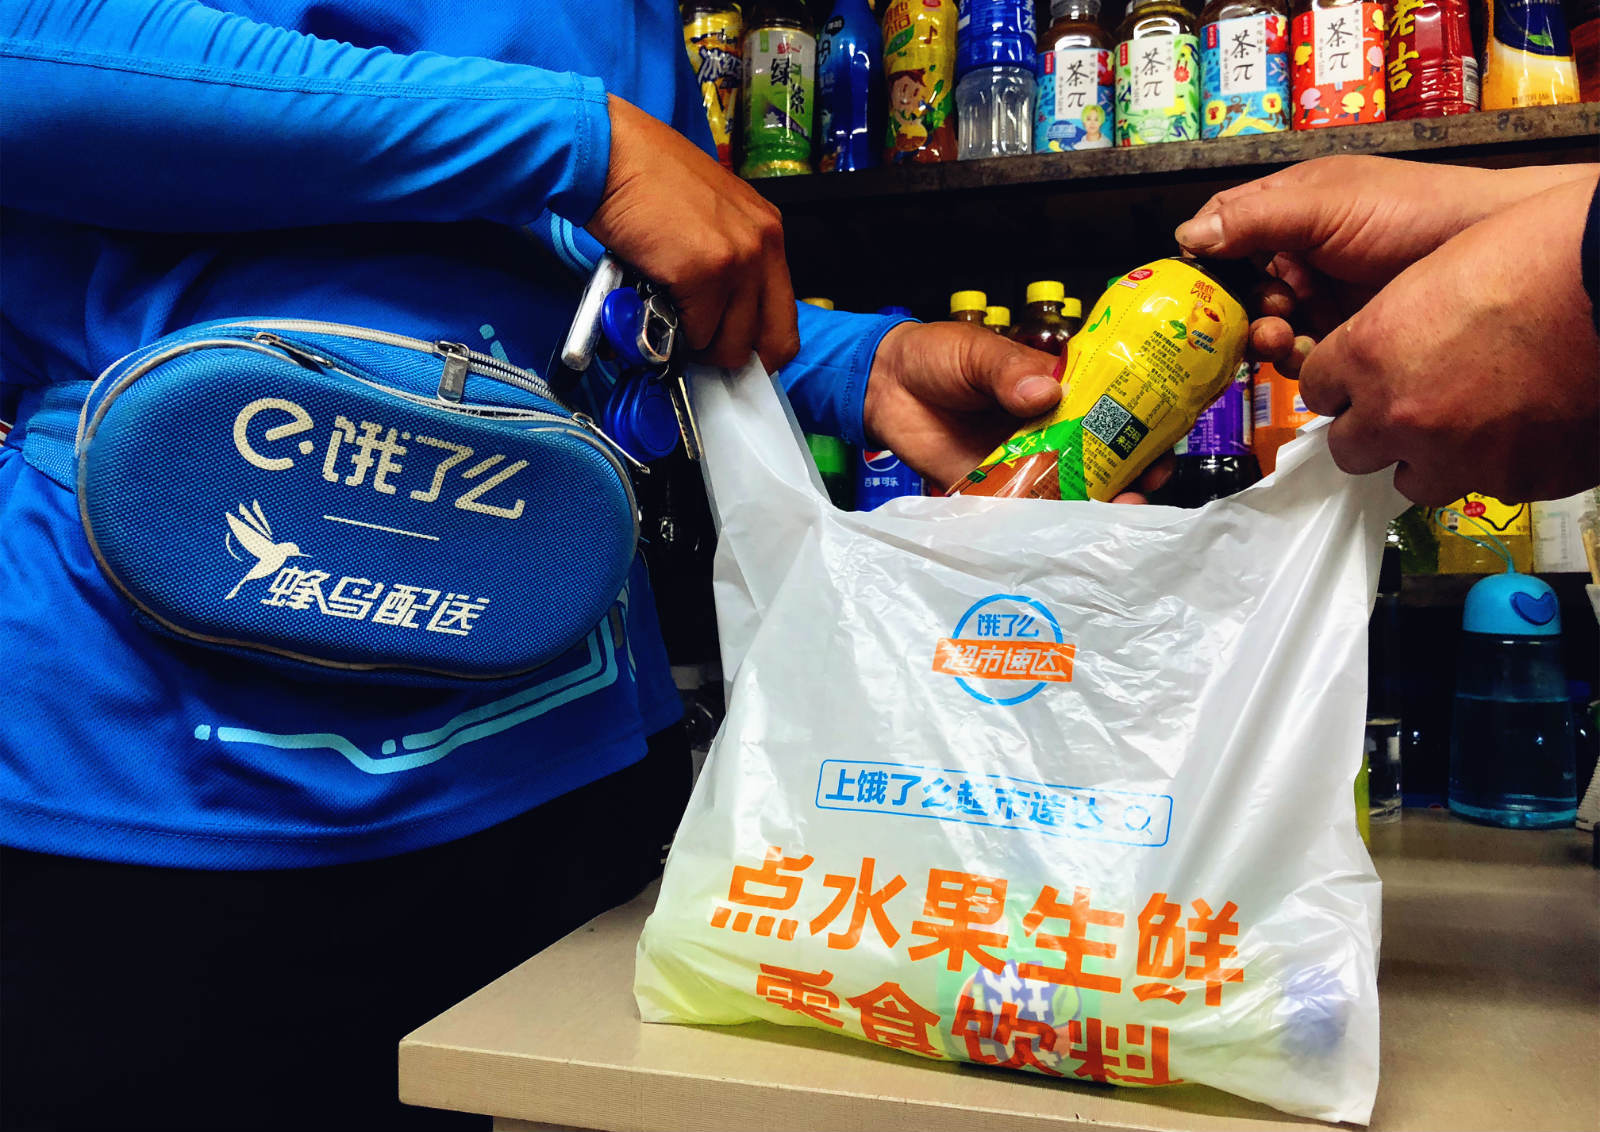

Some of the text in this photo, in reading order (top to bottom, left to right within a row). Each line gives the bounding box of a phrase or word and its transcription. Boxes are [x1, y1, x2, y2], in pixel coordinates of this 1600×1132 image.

[771, 57, 804, 115] 绿茶
[322, 414, 529, 520] 饿了么
[864, 476, 900, 488] 百事可乐
[261, 565, 490, 636] 蜂鸟配送
[977, 613, 1040, 638] 饿了么
[941, 644, 1067, 677] 超市速达
[709, 847, 1244, 1007] 点水果生鲜
[756, 963, 1185, 1086] 零食饮料
